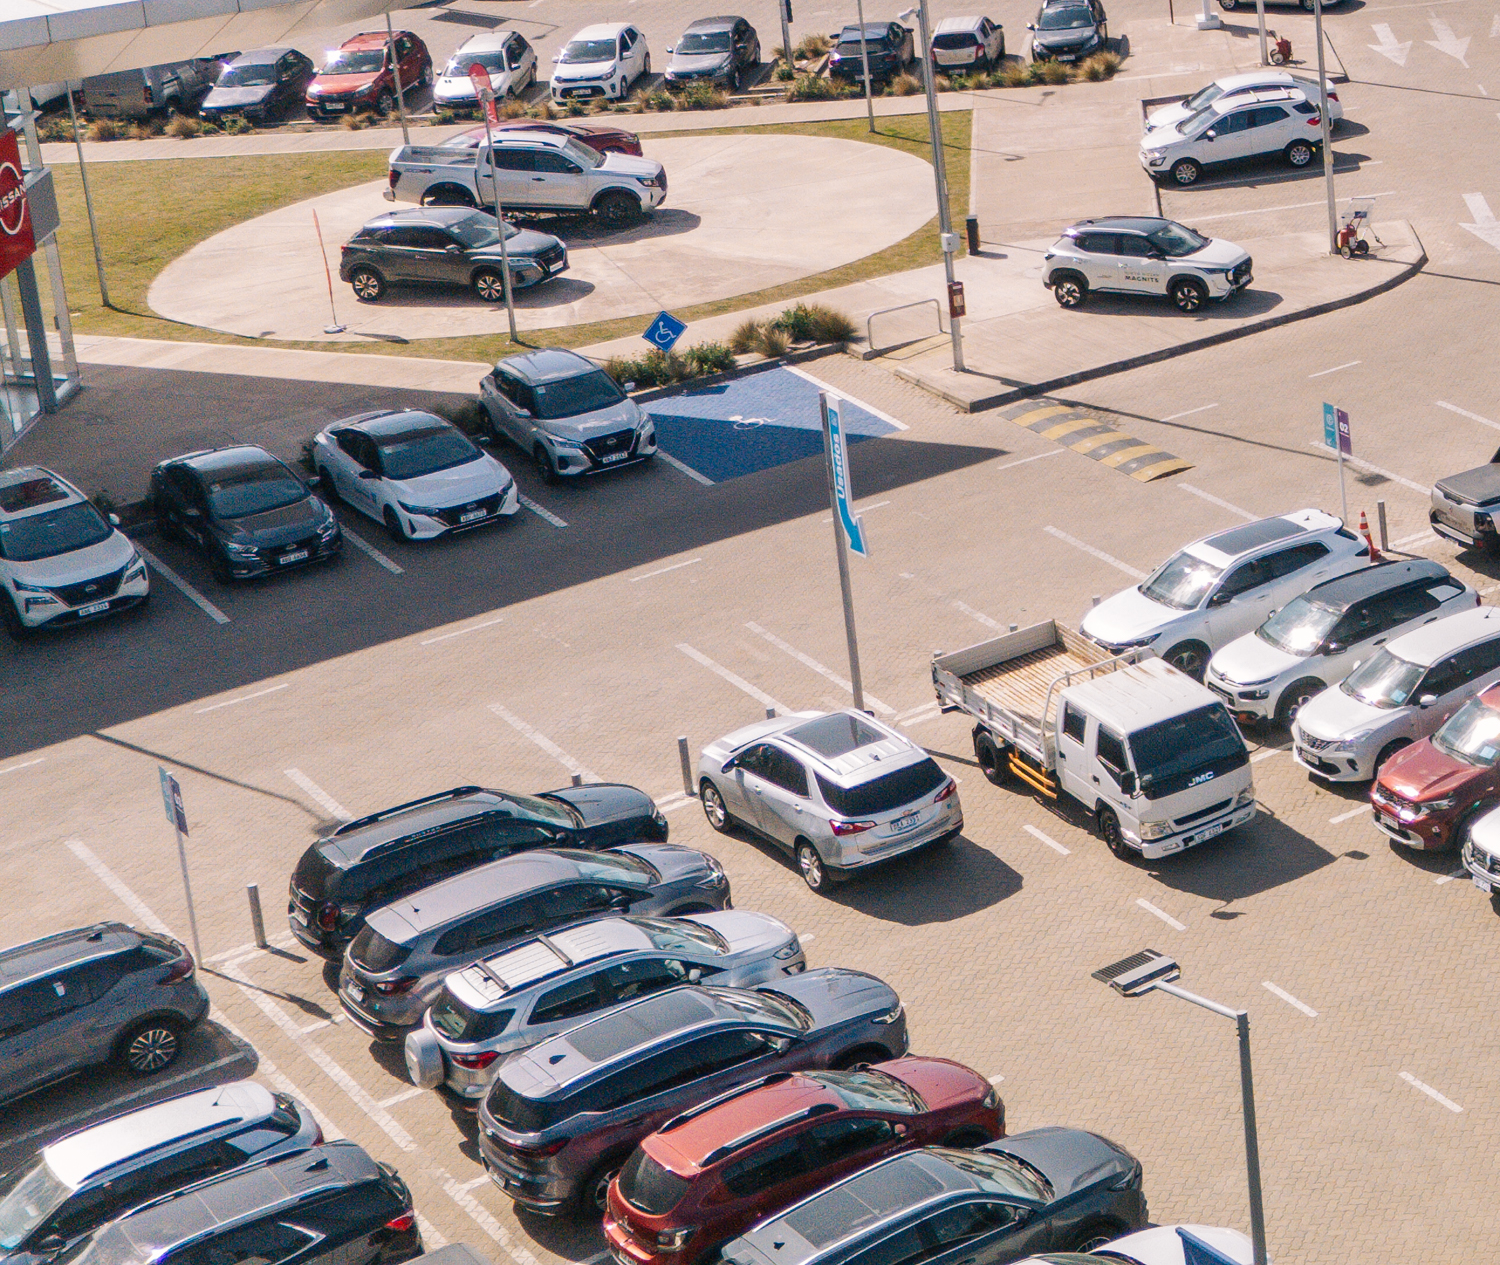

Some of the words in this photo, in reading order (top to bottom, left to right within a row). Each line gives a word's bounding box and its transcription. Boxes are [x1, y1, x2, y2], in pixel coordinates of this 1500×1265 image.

[0, 184, 27, 211] ISSAN
[1339, 421, 1349, 433] 02
[832, 433, 846, 500] Usados
[1188, 771, 1214, 787] JMC
